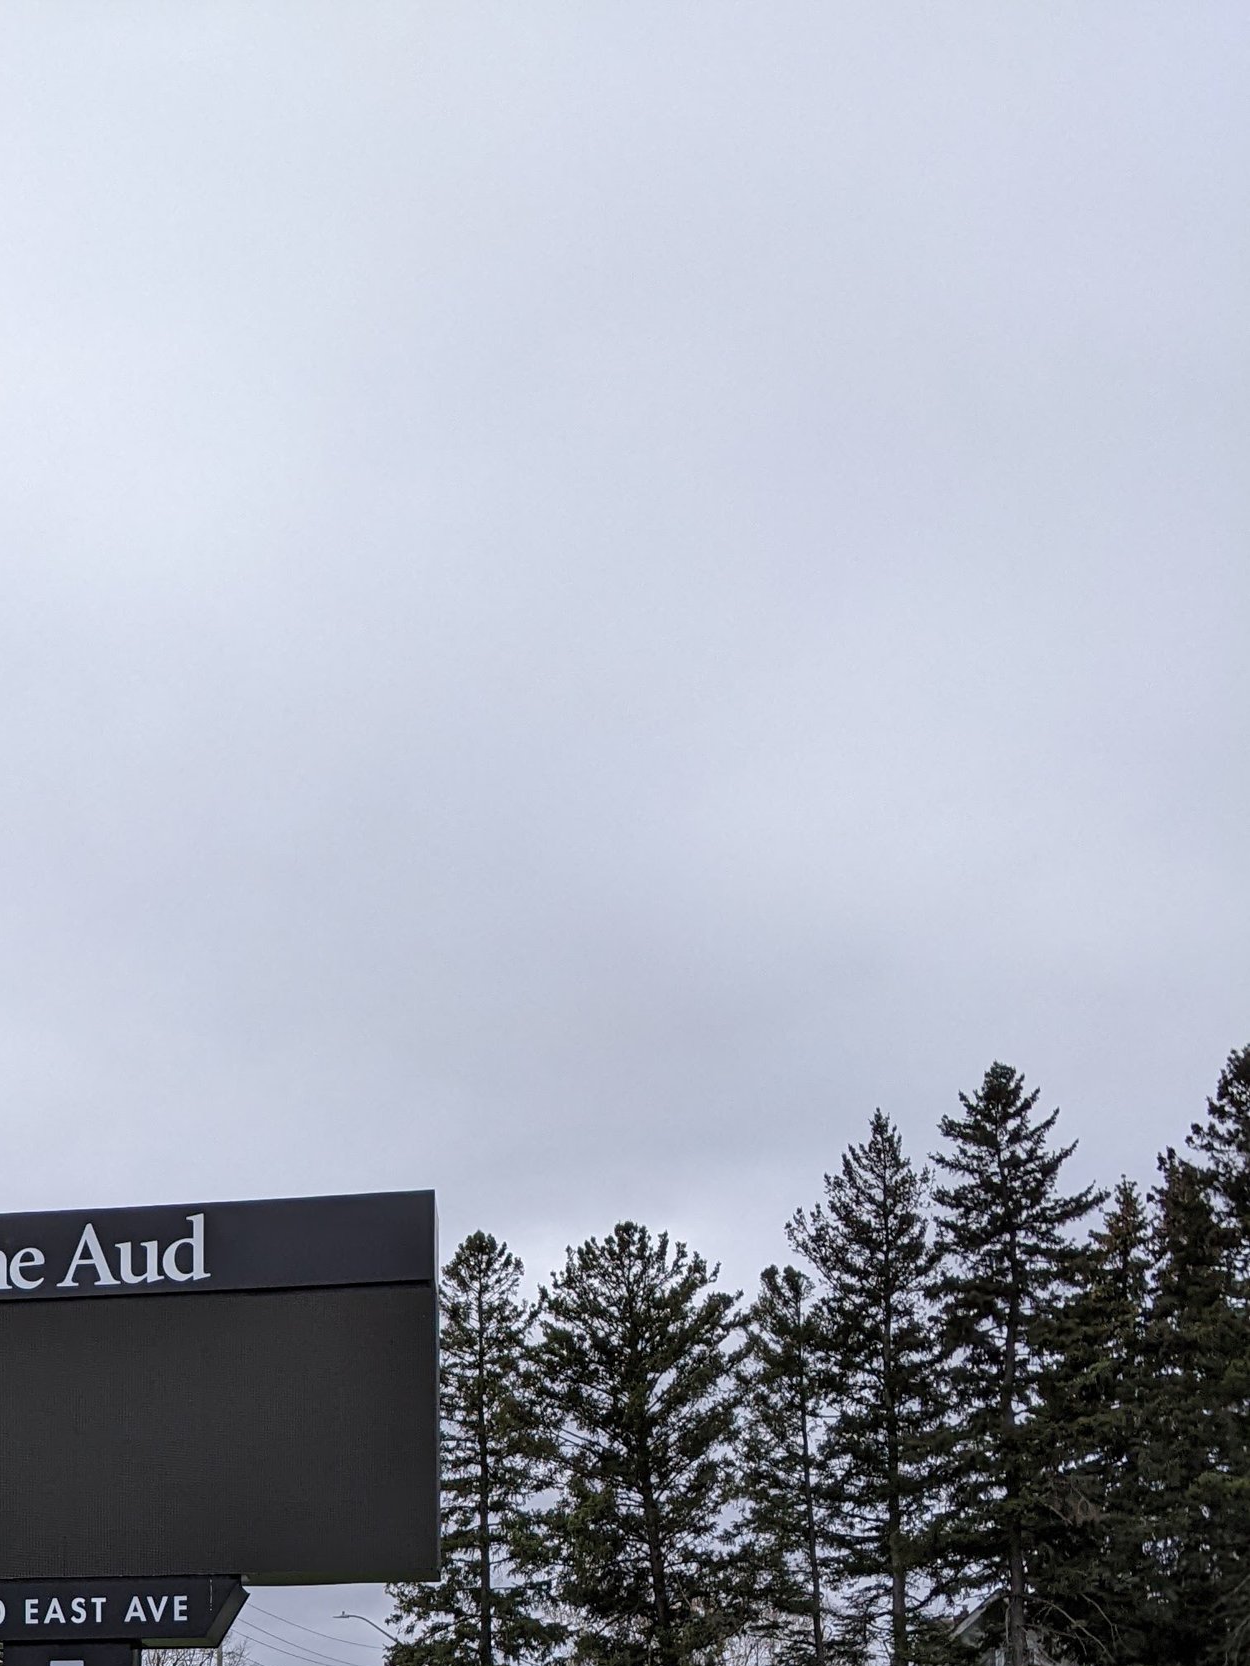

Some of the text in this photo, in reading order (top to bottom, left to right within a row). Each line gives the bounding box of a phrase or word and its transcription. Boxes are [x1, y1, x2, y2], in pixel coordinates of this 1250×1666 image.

[56, 1212, 211, 1288] Aud
[24, 1596, 107, 1625] EAST
[124, 1595, 189, 1623] AVE
